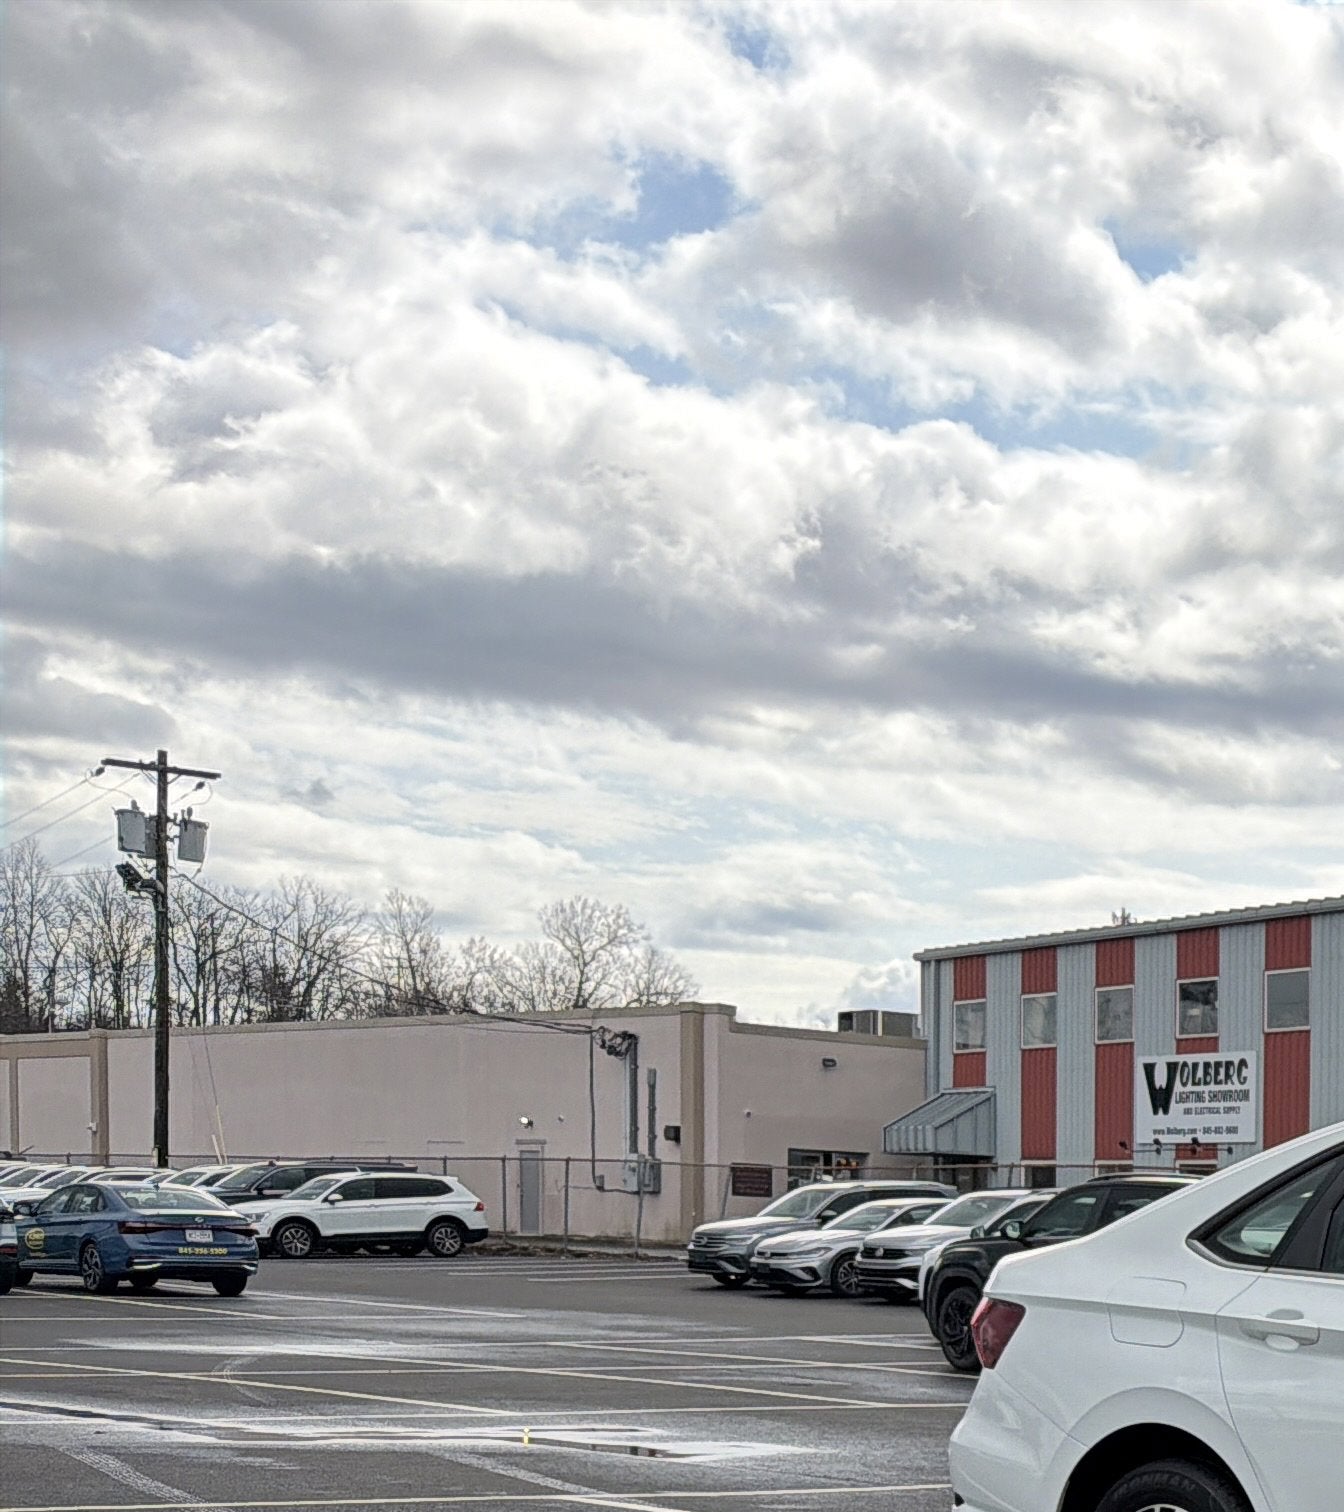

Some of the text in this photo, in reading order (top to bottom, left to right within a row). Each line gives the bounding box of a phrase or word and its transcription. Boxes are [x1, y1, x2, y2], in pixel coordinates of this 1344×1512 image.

[1142, 1058, 1248, 1115] WOLBERG
[1175, 1089, 1250, 1104] LIGHTING SHOWROOM
